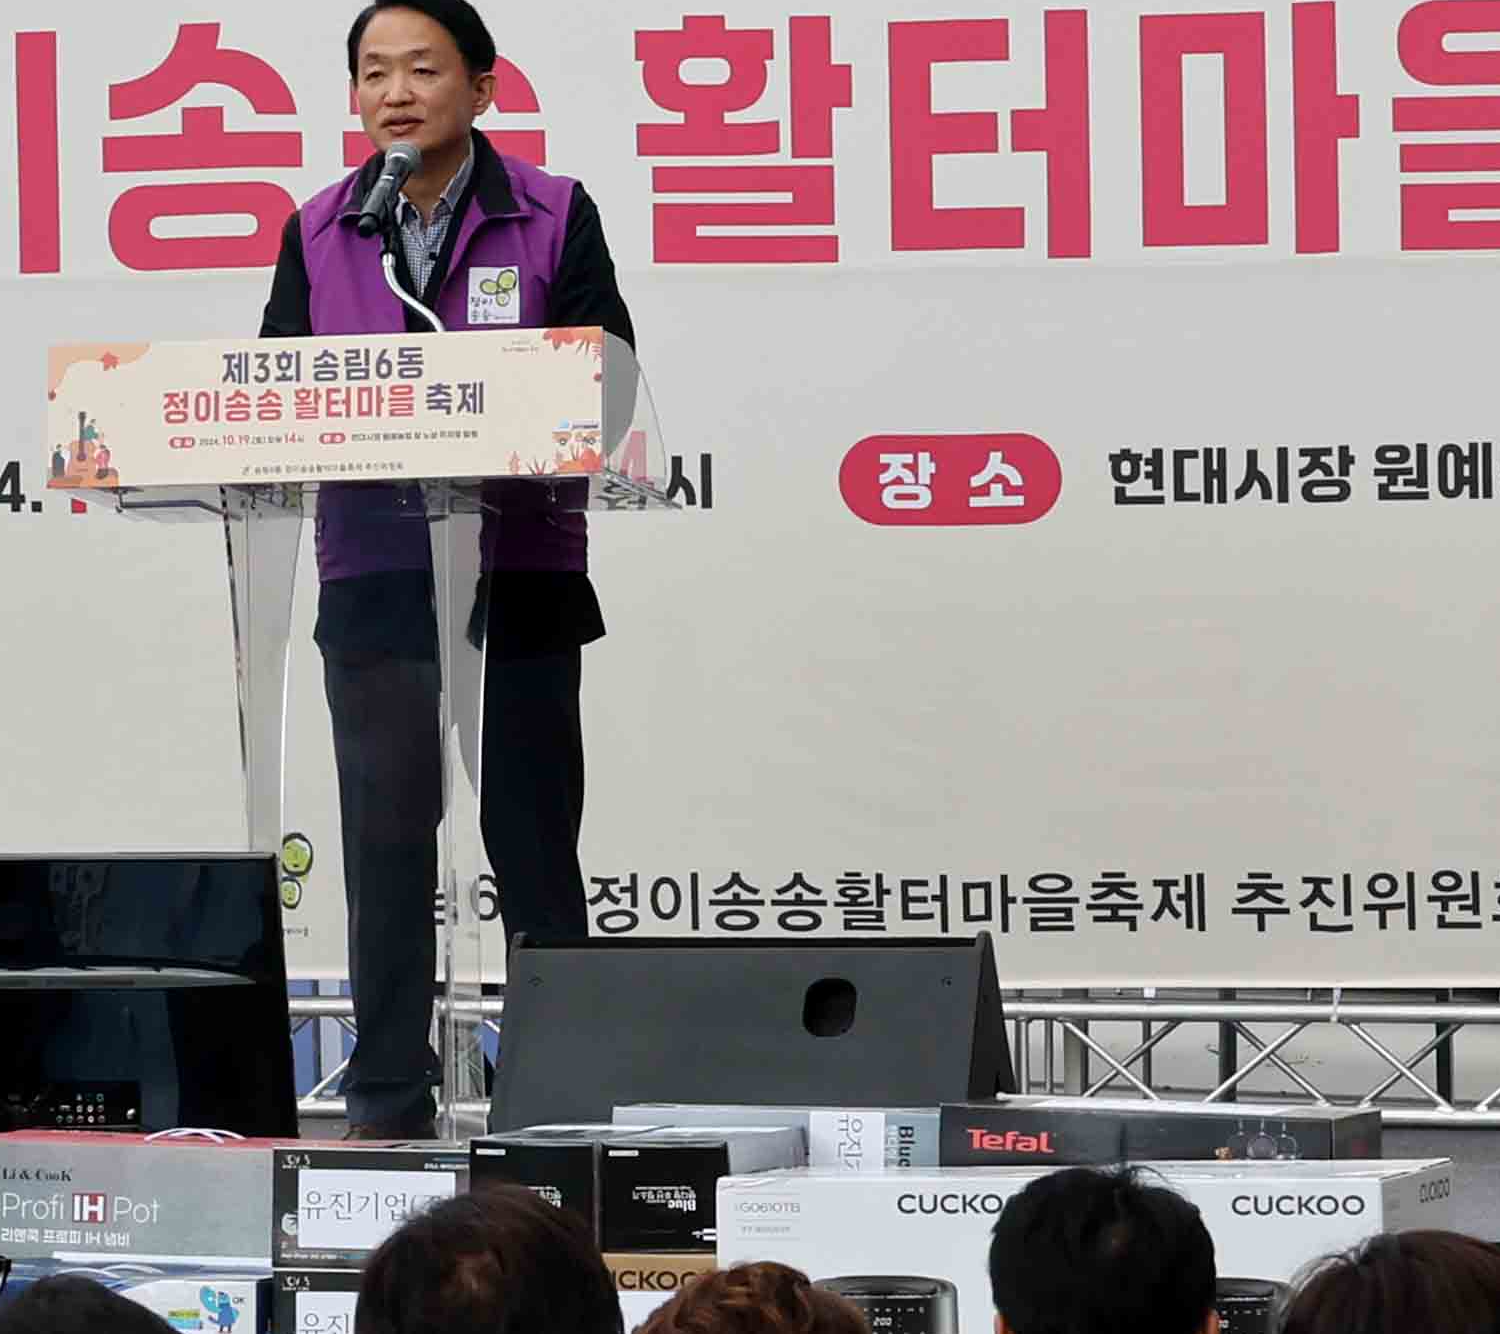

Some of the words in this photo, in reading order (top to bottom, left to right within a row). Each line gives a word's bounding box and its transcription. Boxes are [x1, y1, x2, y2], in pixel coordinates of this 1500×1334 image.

[221, 351, 302, 384] 제3회
[313, 346, 424, 382] 송림6동
[163, 389, 283, 424] 정이송송
[293, 383, 415, 420] 활터마을
[425, 381, 485, 415] 축제
[1108, 445, 1354, 507] 현대시장
[587, 870, 1207, 935] 정이송송활터마을축제
[967, 1128, 1056, 1154] Tefal
[1, 1191, 65, 1221] Profi
[72, 1194, 106, 1222] IH
[112, 1196, 161, 1224] Pot
[897, 1194, 1001, 1214] CUCKO
[1231, 1195, 1366, 1216] CUCKOO
[42, 1228, 82, 1245] 프로피
[84, 1230, 101, 1245] IH
